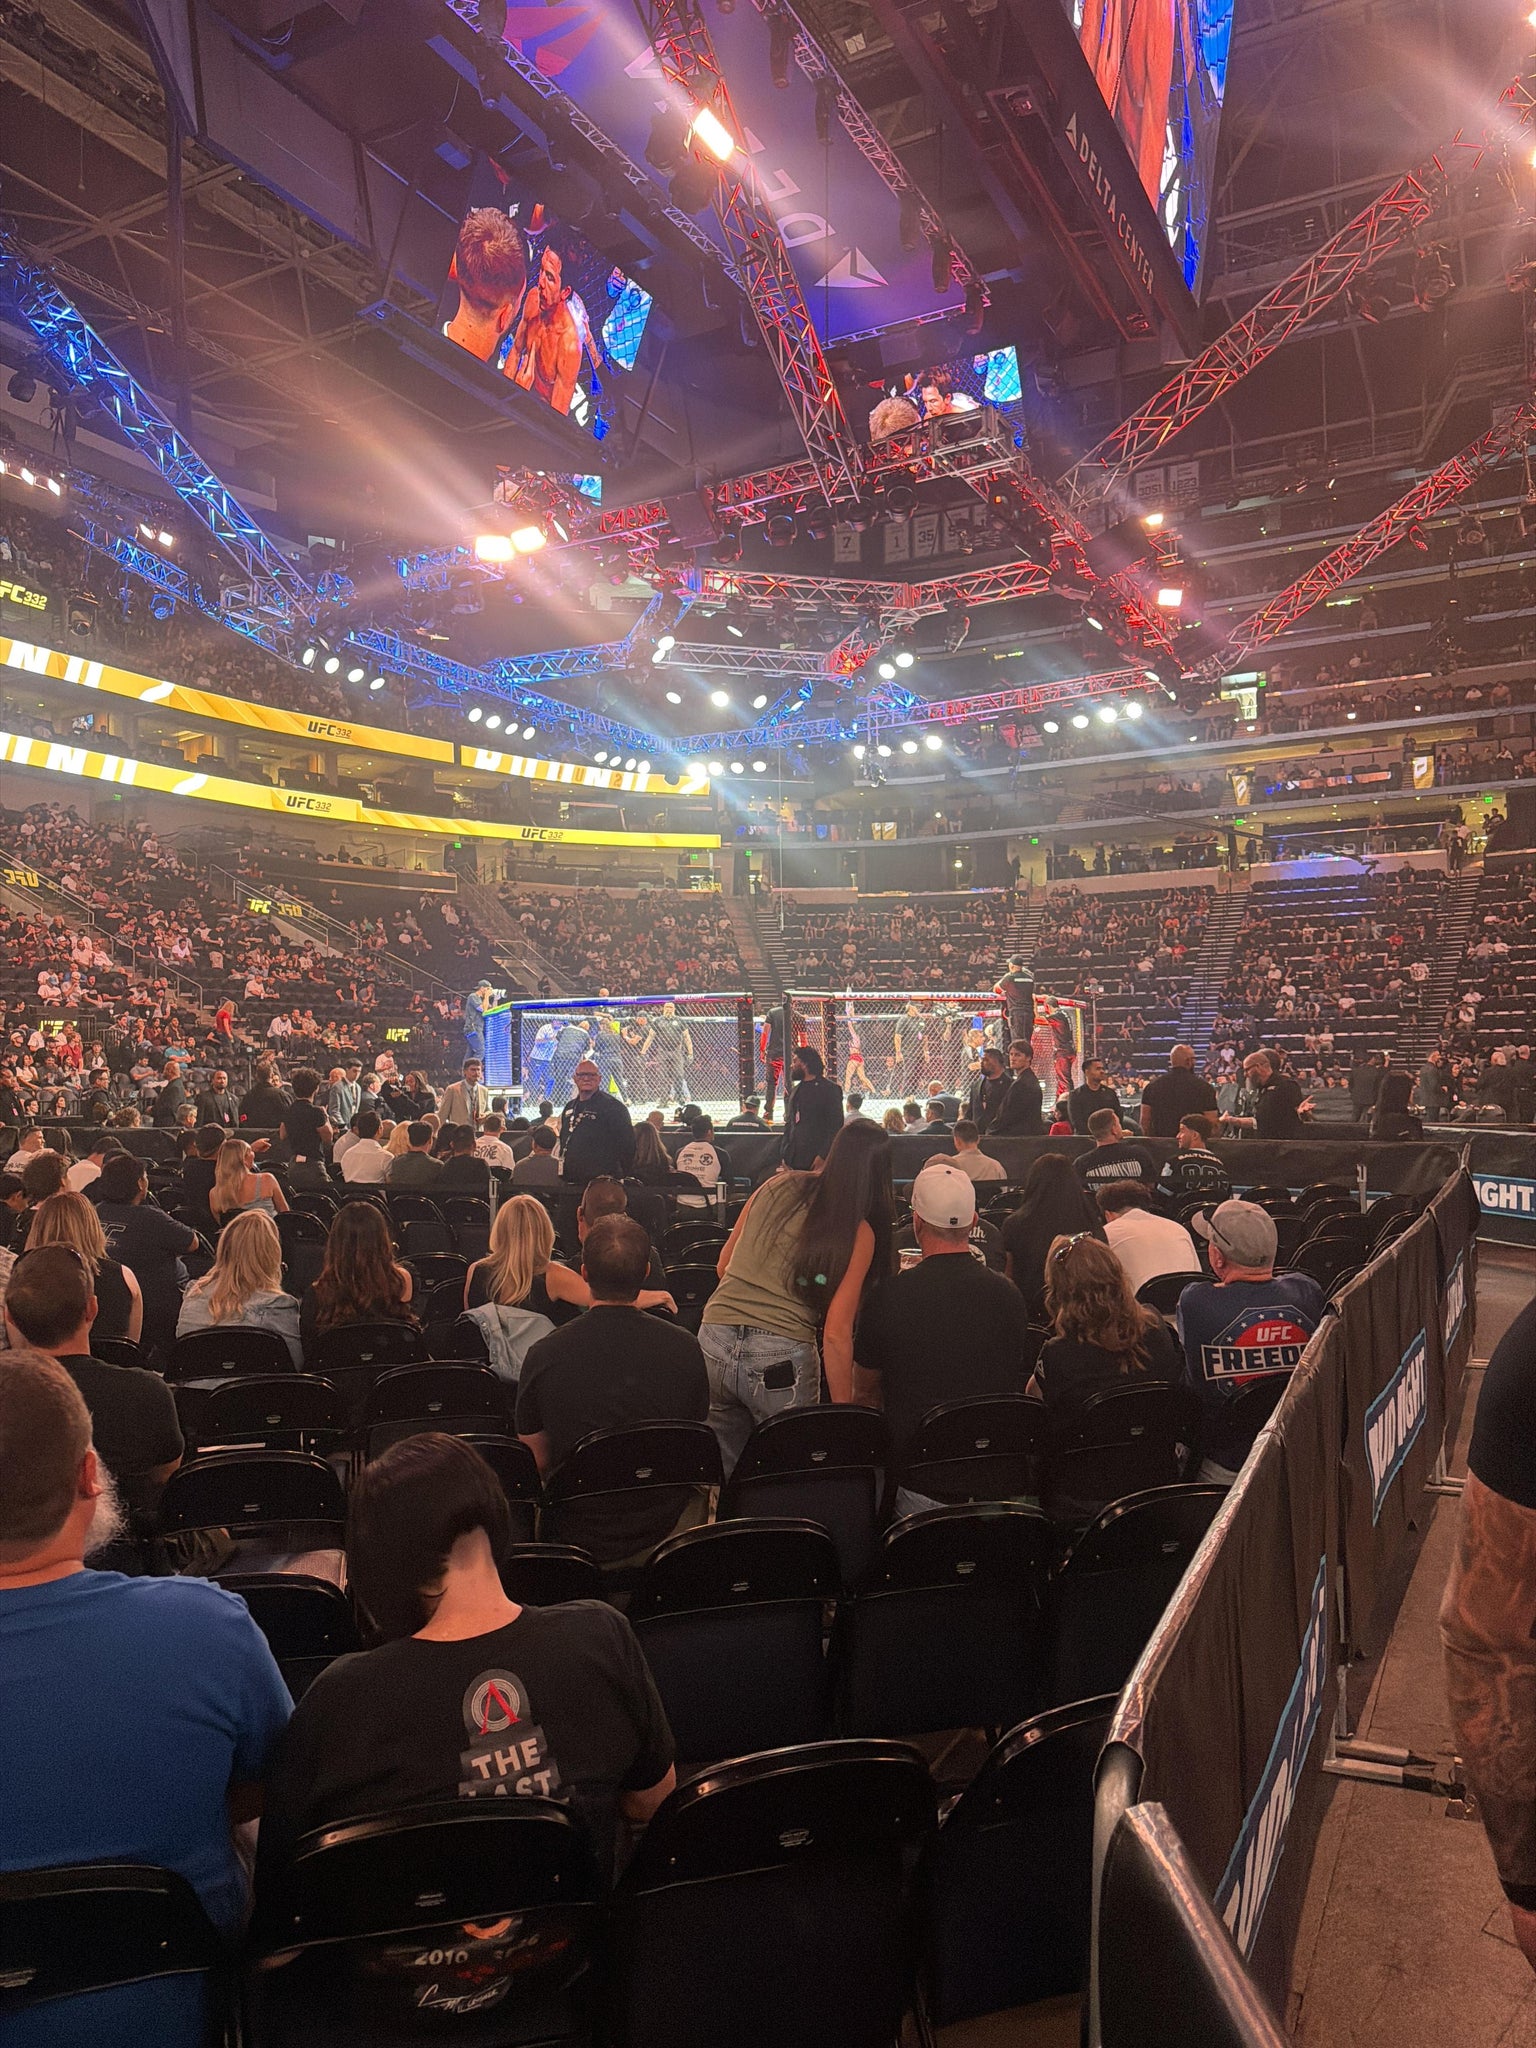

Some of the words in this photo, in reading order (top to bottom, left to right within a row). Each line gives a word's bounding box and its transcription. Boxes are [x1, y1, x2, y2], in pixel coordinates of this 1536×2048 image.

[1079, 132, 1116, 223] DELTA
[1118, 212, 1155, 295] CENTER
[918, 529, 934, 544] 35
[0, 580, 26, 604] FC
[307, 720, 337, 737] UFC
[286, 795, 316, 810] UFC
[521, 827, 548, 840] UFC
[1256, 1325, 1292, 1342] UFC
[1203, 1343, 1308, 1378] FREED
[470, 1737, 541, 1780] THE
[468, 1769, 552, 1797] AST
